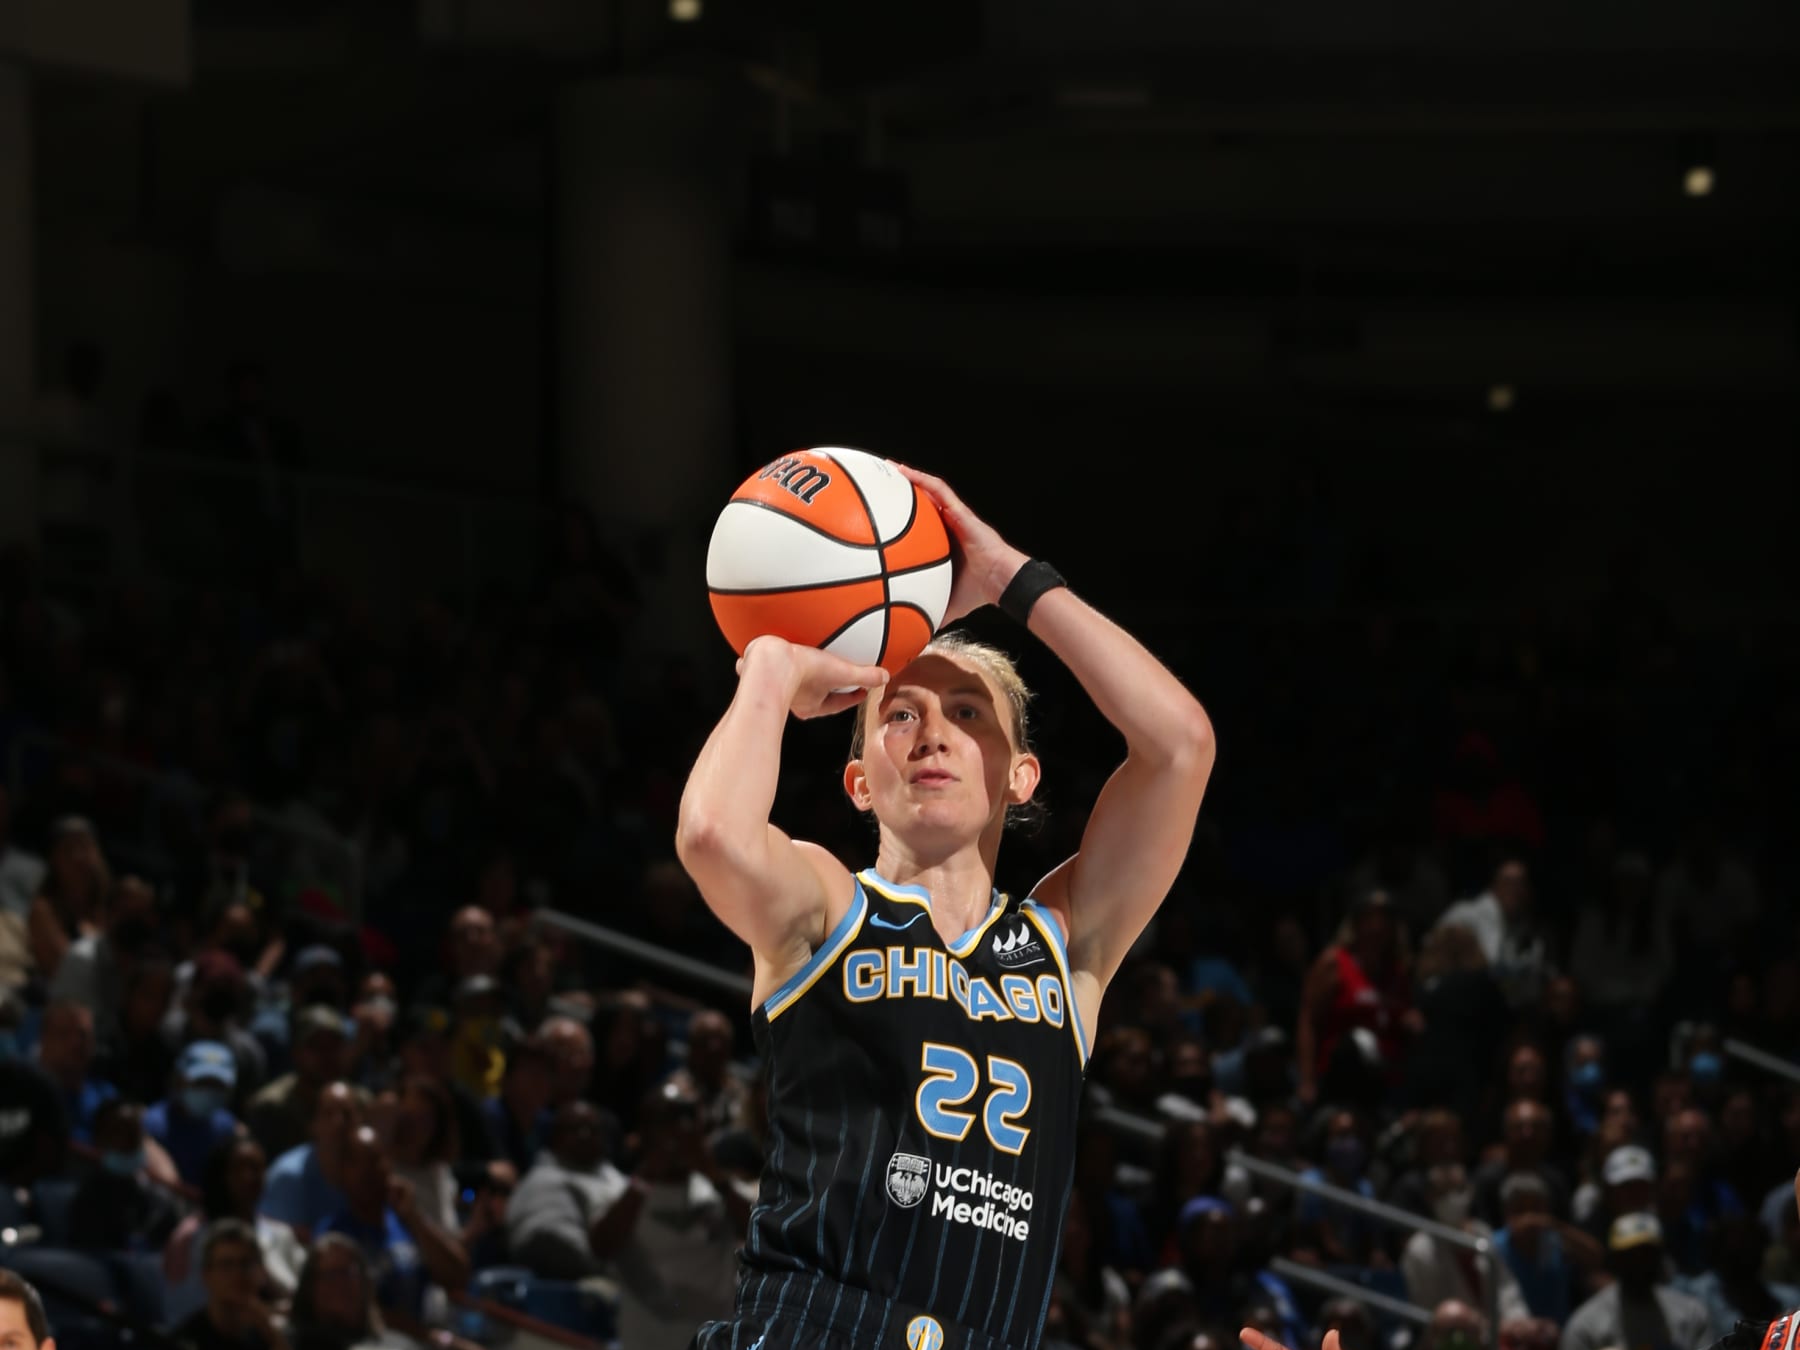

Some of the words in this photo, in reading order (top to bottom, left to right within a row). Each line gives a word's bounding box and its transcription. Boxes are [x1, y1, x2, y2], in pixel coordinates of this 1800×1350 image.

[843, 945, 1064, 1029] CHICAGO
[916, 1041, 1031, 1155] 22
[936, 1163, 1033, 1211] UChicago
